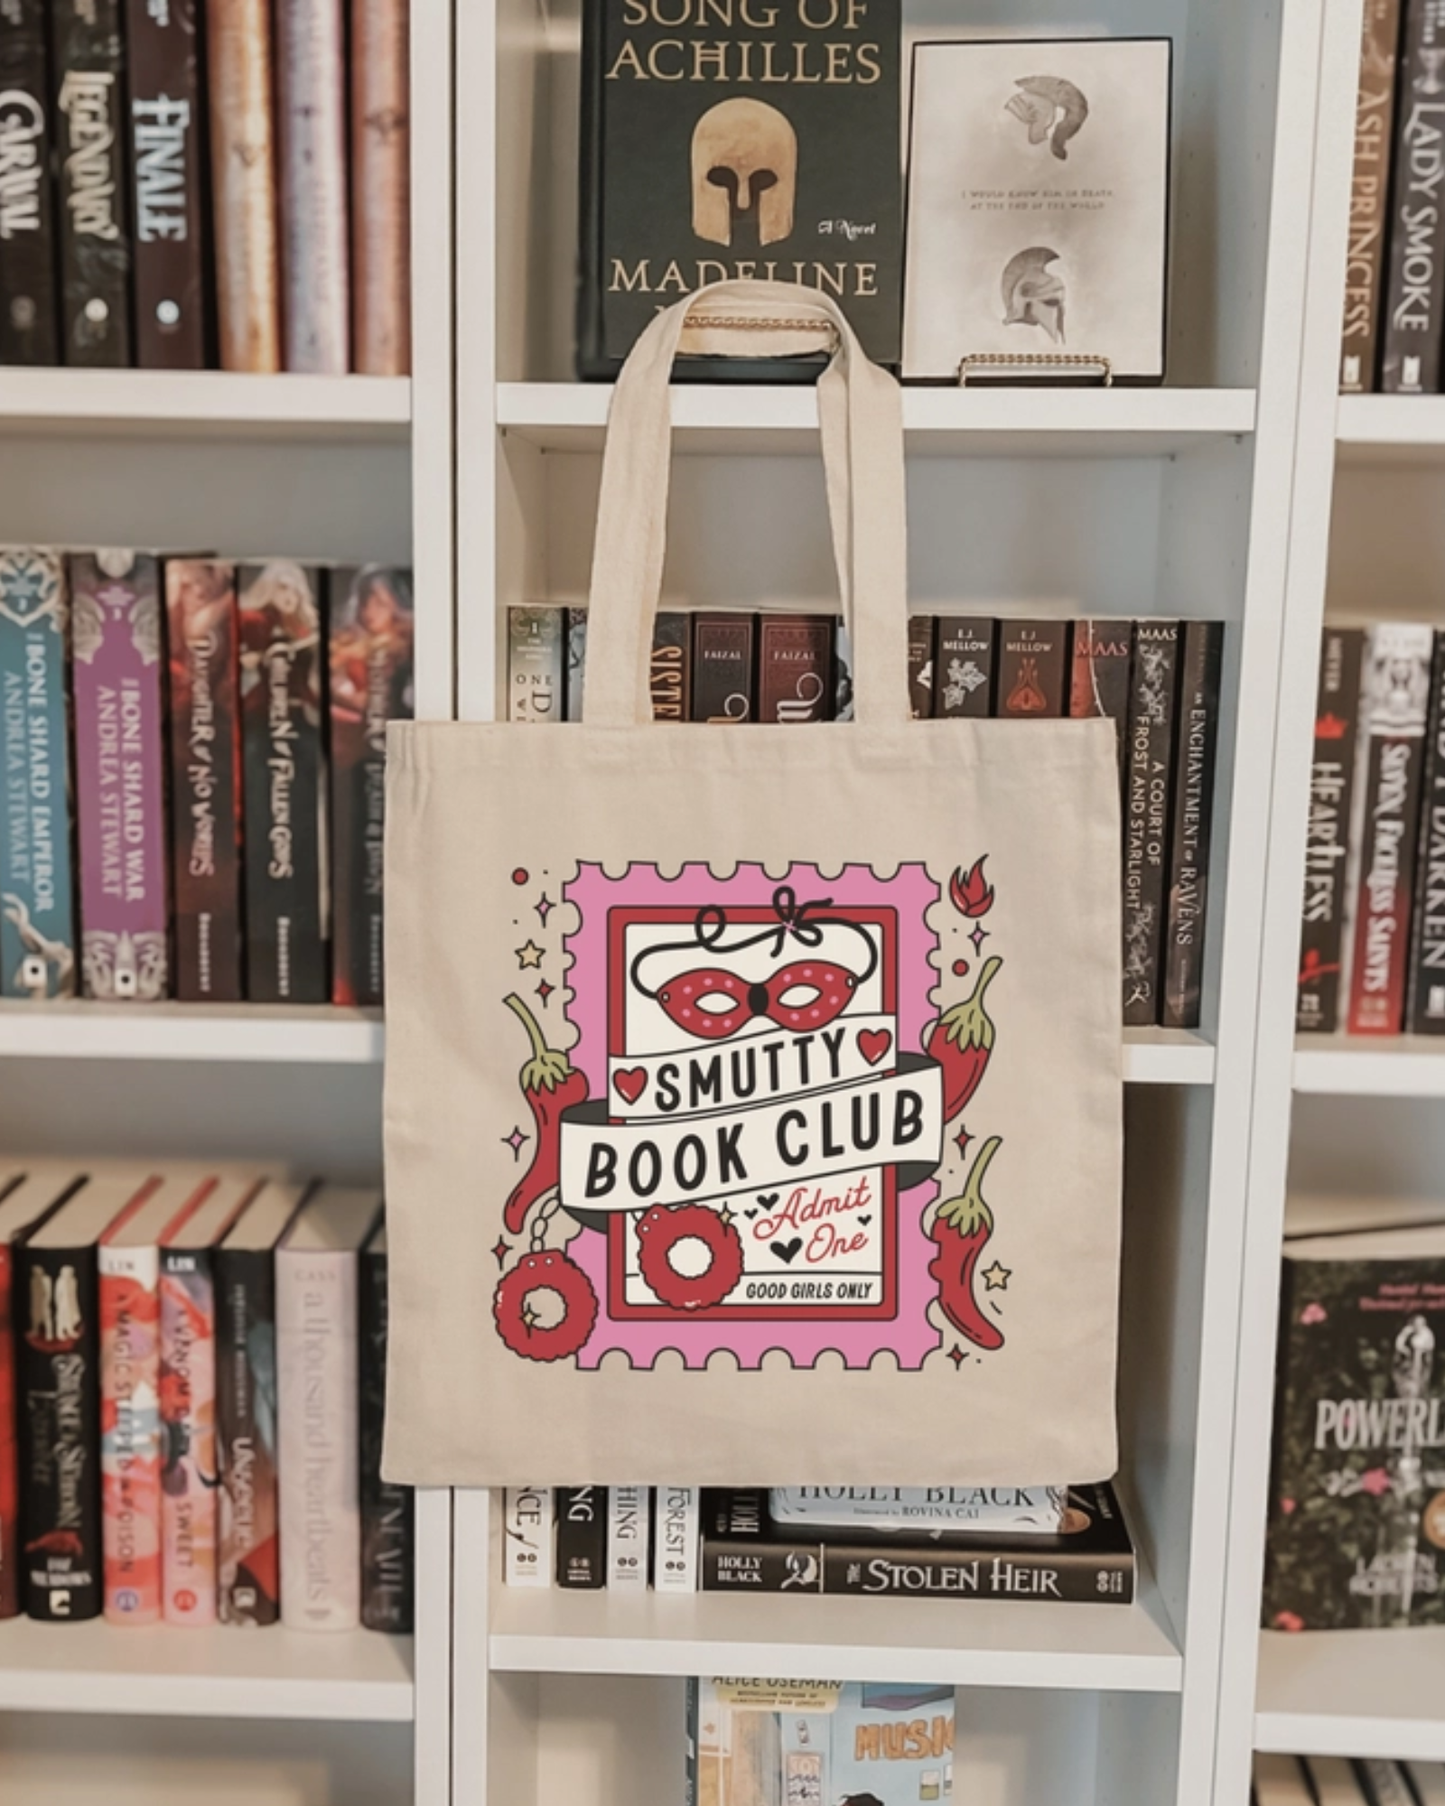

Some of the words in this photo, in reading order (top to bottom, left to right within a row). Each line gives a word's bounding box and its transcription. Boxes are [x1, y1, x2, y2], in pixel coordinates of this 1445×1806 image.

[623, 0, 780, 27] SONG
[797, 0, 867, 29] OF
[604, 39, 882, 84] ACHILLES
[1354, 87, 1390, 160] ASH
[1404, 101, 1445, 200] LADY
[132, 93, 190, 243] FINALE
[817, 220, 833, 235] A
[836, 219, 878, 241] Novel
[1342, 175, 1381, 338] PRINCESS
[1393, 205, 1438, 332] SMOKE
[704, 651, 741, 660] FAIZAL
[774, 651, 815, 661] FAIZAL
[942, 641, 989, 651] MELLOW
[1006, 642, 1053, 652] MELLOW
[1077, 642, 1128, 657] MAAS
[1137, 629, 1177, 640] MAAS
[26, 642, 48, 709] BONE
[516, 674, 553, 686] ONE
[4, 670, 27, 771] ANDREA
[97, 684, 119, 785] ANDREA
[121, 689, 142, 753] BONE
[1134, 715, 1150, 770] FROST
[28, 715, 51, 798] SHARD
[1152, 761, 1165, 773] A
[1183, 709, 1207, 848] ENCHANTMENT
[122, 760, 145, 843] SHARD
[1131, 776, 1146, 813] AND
[1148, 778, 1165, 836] COURT
[7, 778, 31, 882] STEWART
[100, 792, 123, 898] STEWART
[1146, 842, 1161, 866] OF
[1303, 762, 1346, 922] HEARTLESS
[31, 805, 54, 912] EMPEROR
[125, 848, 146, 902] WAR
[1126, 819, 1145, 910] STARLIGHT
[1176, 867, 1201, 945] RAVENS
[654, 1027, 846, 1112] SMUTTY
[584, 1122, 748, 1199] BOOK
[776, 1089, 923, 1166] CLUB
[752, 1176, 872, 1239] Admit
[108, 1259, 136, 1271] LIN
[167, 1256, 196, 1271] LIN
[805, 1223, 869, 1263] One
[746, 1282, 788, 1299] GOOD
[790, 1282, 834, 1299] GIRLS
[836, 1282, 873, 1299] ONLY
[1314, 1399, 1445, 1450] POWERL
[663, 1487, 691, 1556] FOREST
[902, 1507, 951, 1518] ROVINA
[955, 1508, 979, 1519] CAI
[925, 1487, 1034, 1506] BLACK
[717, 1556, 763, 1570] HOLLY
[717, 1570, 763, 1583] BLACK
[862, 1558, 979, 1591] STOLEN
[989, 1556, 1062, 1597] HEIR
[766, 1677, 843, 1690] OSEMAN
